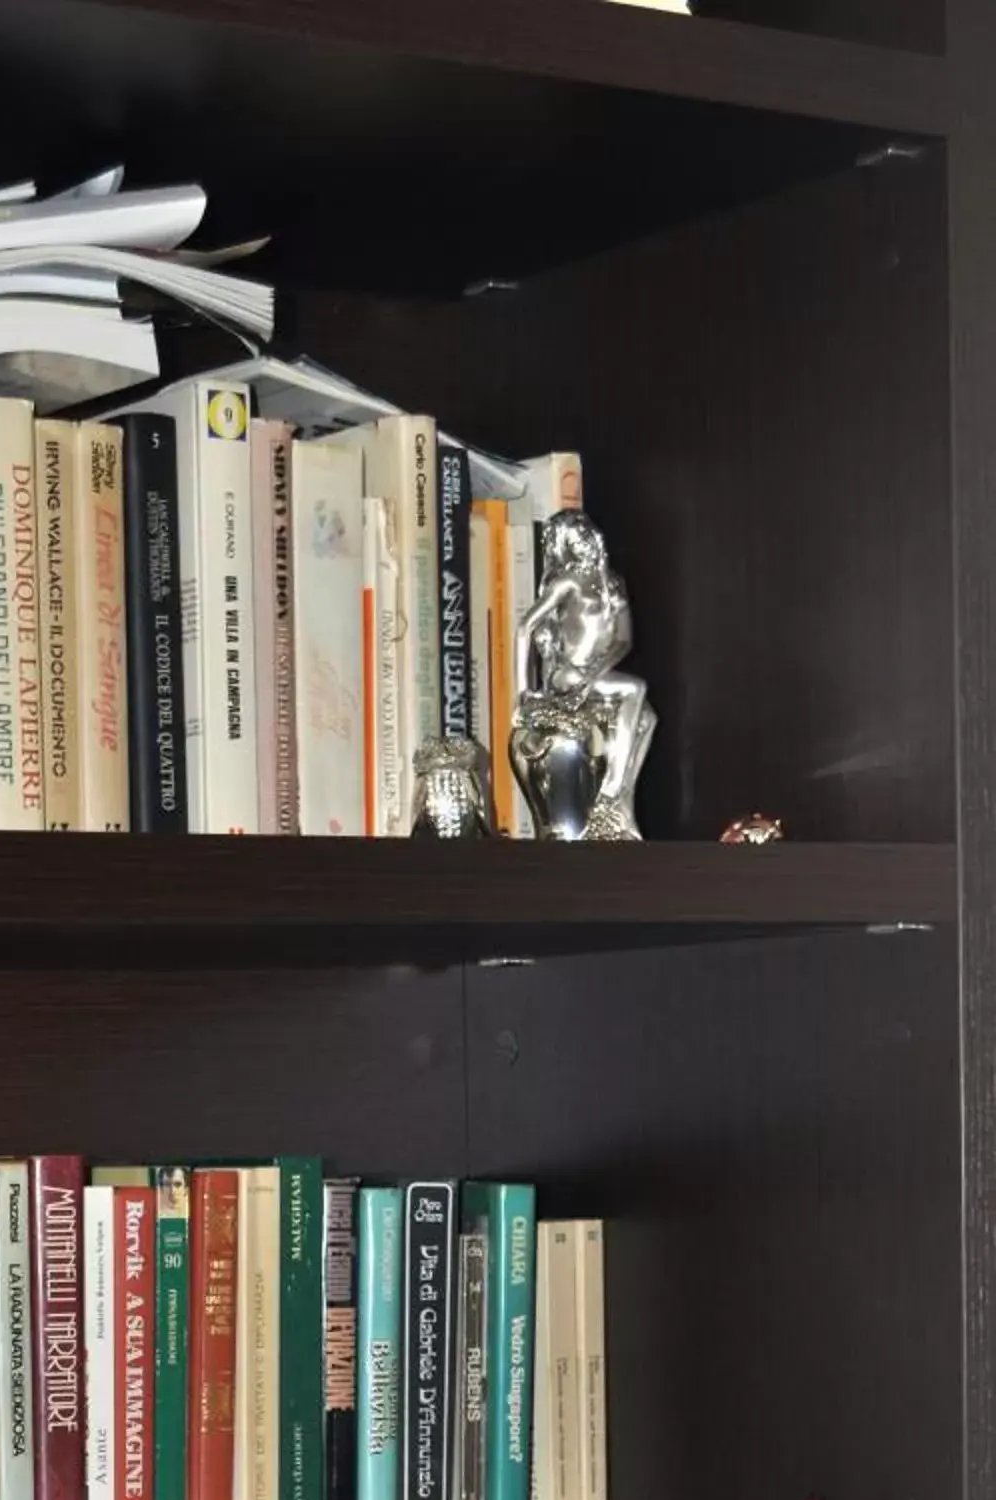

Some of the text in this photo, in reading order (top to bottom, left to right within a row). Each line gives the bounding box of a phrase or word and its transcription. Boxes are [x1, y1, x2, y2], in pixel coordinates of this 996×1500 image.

[94, 506, 115, 592] Linea
[11, 463, 42, 810] DOMINIQUE LAPIERRE
[44, 440, 67, 778] IRVING DOCUMENTO
[444, 569, 465, 647] ANNI
[90, 637, 123, 752] Sangue
[155, 630, 171, 696] CODICE
[225, 575, 241, 740] UNA VILLA IN CAMPAGNA
[156, 699, 172, 727] DEL
[157, 731, 175, 810] QUATTRO
[290, 1173, 303, 1260] MAUGHAM
[8, 1263, 23, 1281] LA
[42, 1185, 79, 1433] MONTANELLI NARRATORE
[9, 1285, 24, 1371] RADUNATA
[125, 1200, 145, 1498] Rorvik A SUA IMMAGINE
[326, 1307, 357, 1410] DEVIAZIONE
[417, 1244, 440, 1498] Vita di Gabriele D'Annunzio
[504, 1215, 527, 1462] CHIARA Vedrò Singapore?
[10, 1372, 26, 1457] SEDIZIOSA
[465, 1346, 481, 1422] RUBENS
